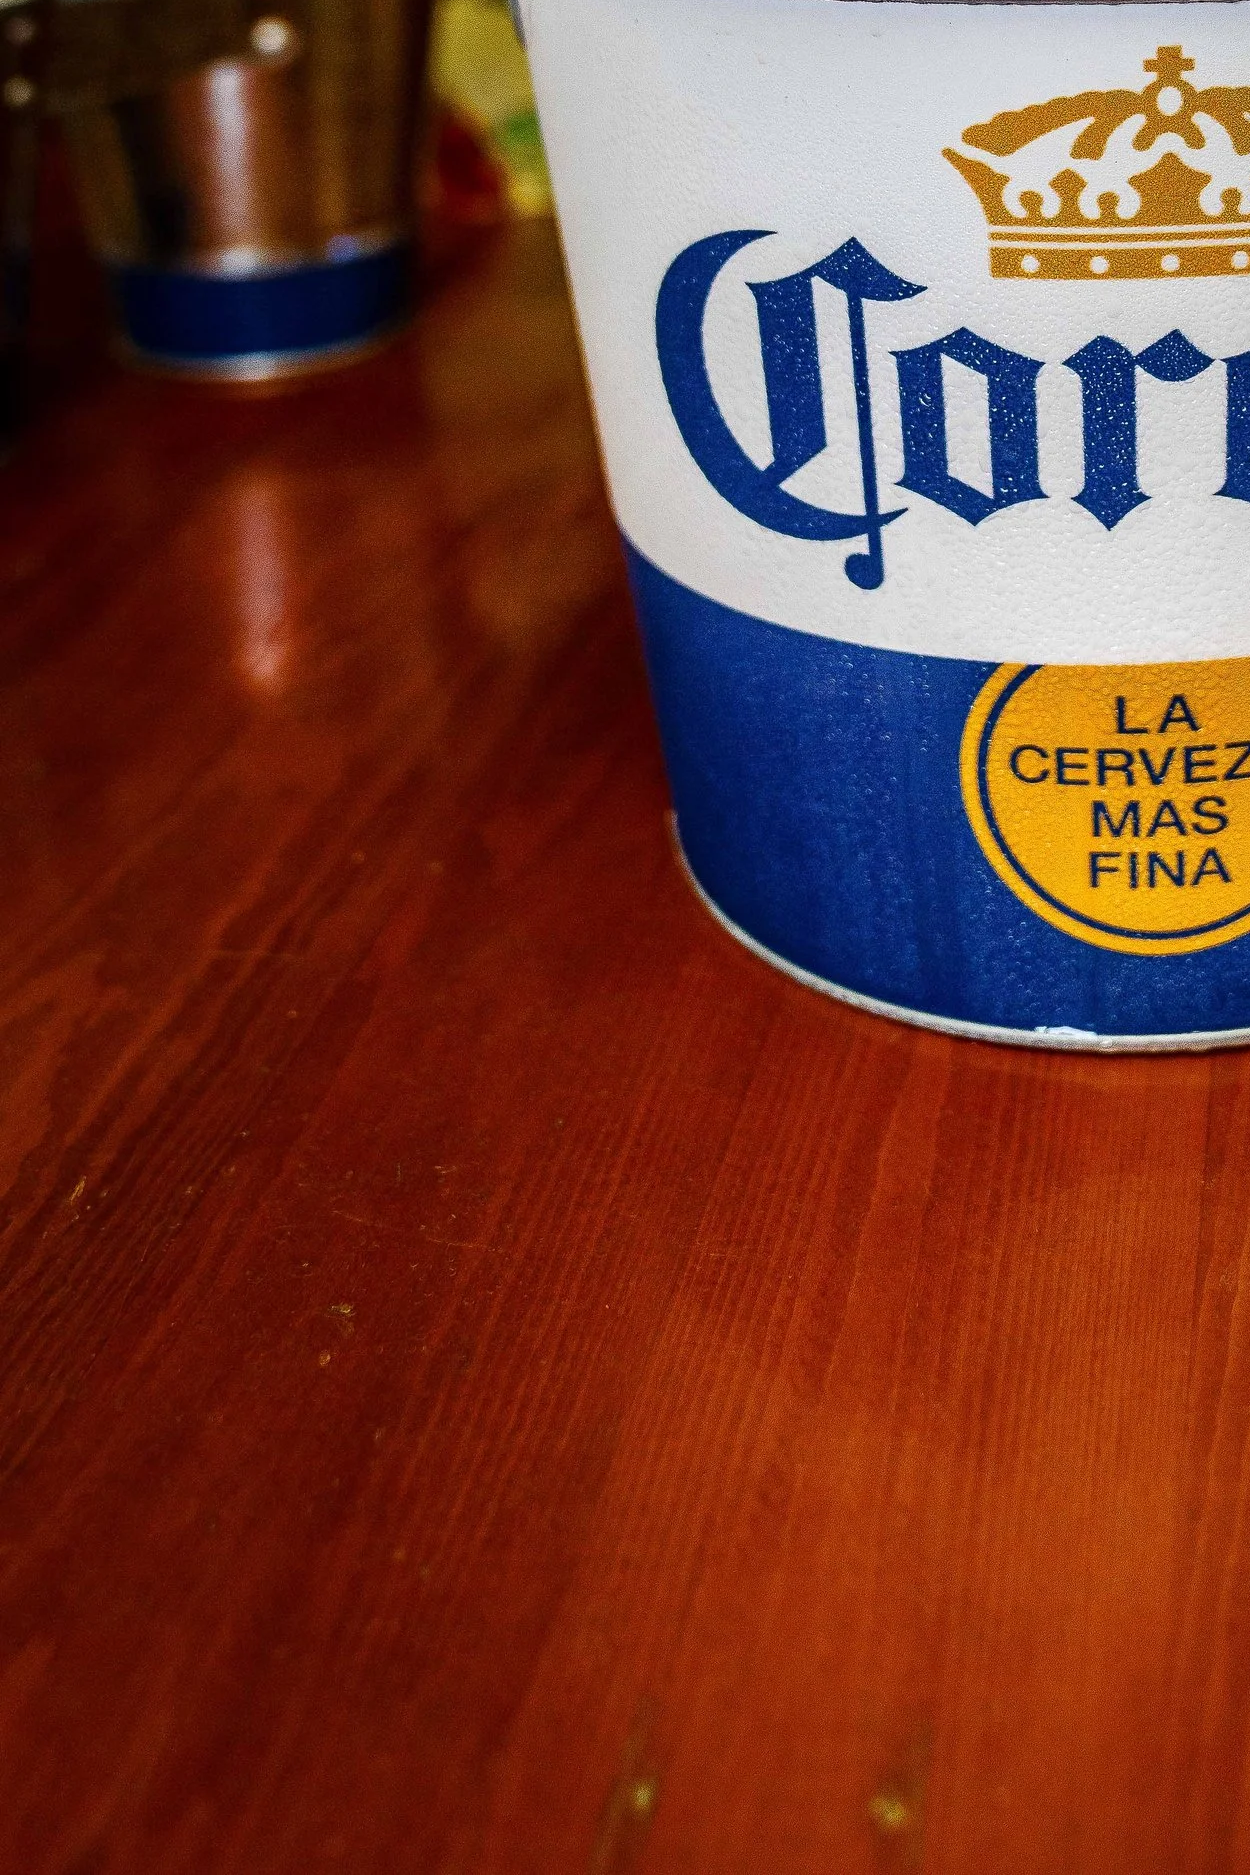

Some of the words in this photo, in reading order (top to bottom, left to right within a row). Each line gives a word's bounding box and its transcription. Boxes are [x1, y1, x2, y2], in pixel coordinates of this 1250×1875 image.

[1116, 693, 1201, 735] LA
[1091, 795, 1230, 838] MAS
[1089, 847, 1234, 889] FINA
